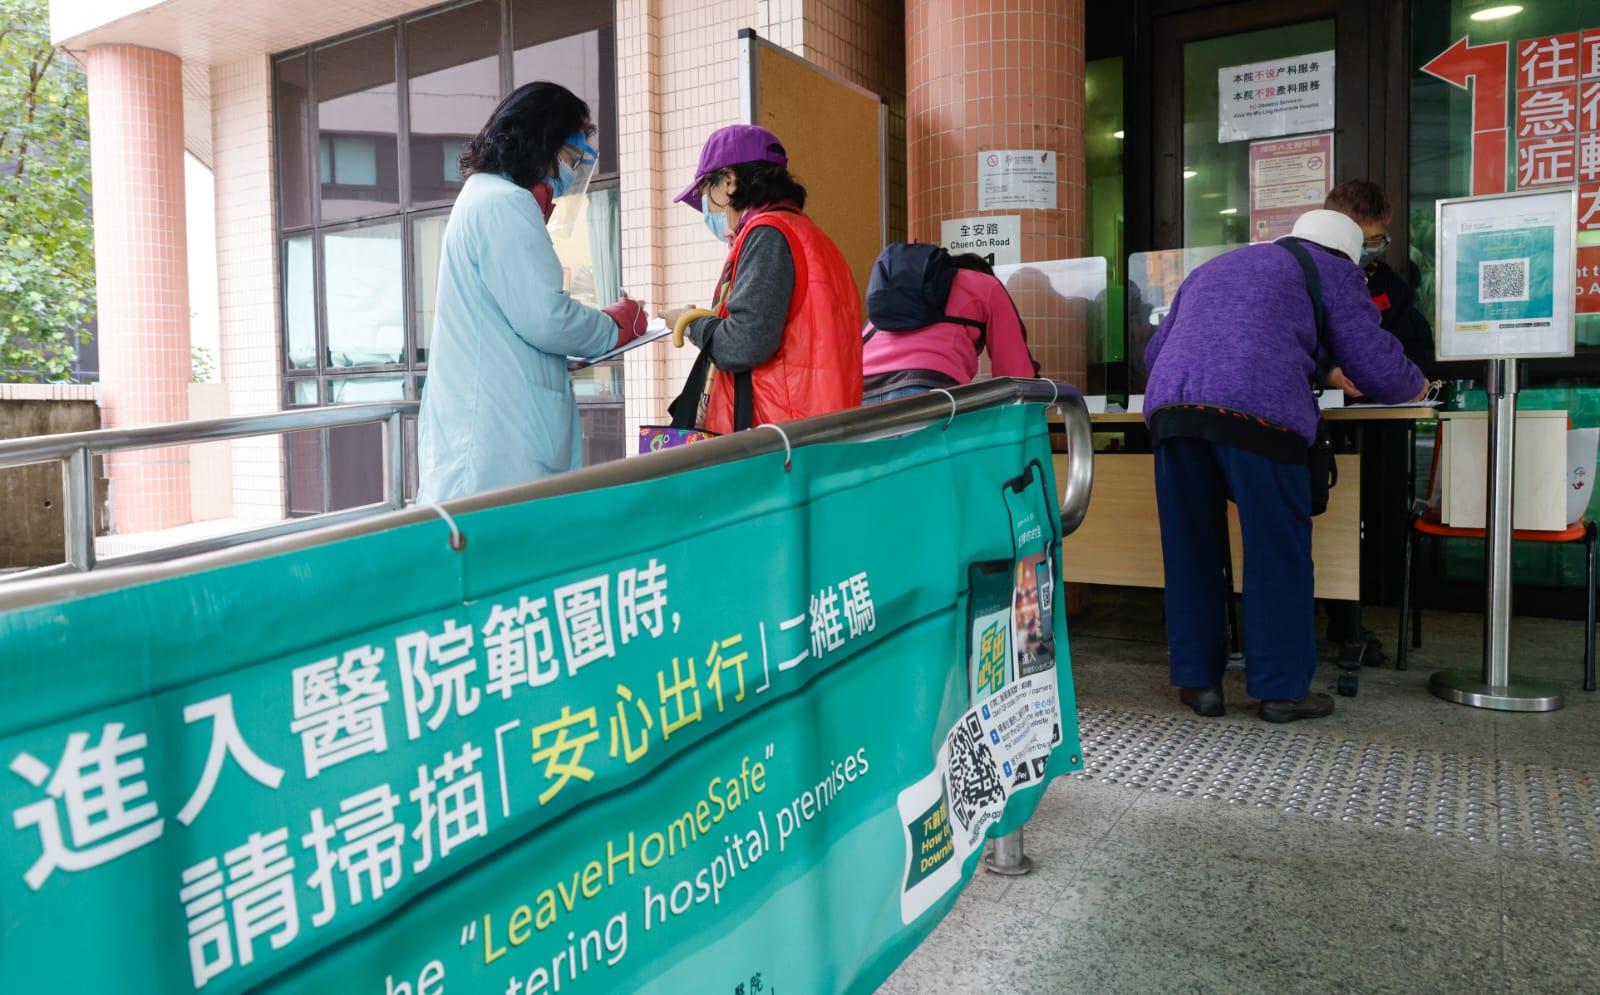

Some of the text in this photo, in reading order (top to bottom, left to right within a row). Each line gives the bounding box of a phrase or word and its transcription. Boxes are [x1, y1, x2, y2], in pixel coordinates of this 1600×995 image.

[1232, 61, 1320, 84] 本院不设产科服务
[1232, 79, 1321, 102] 本院不設產科服務
[959, 223, 999, 238] 全安路
[950, 236, 1010, 249] Chuen On Road
[643, 825, 770, 929] hospital
[777, 745, 870, 851] premises
[921, 830, 943, 854] How
